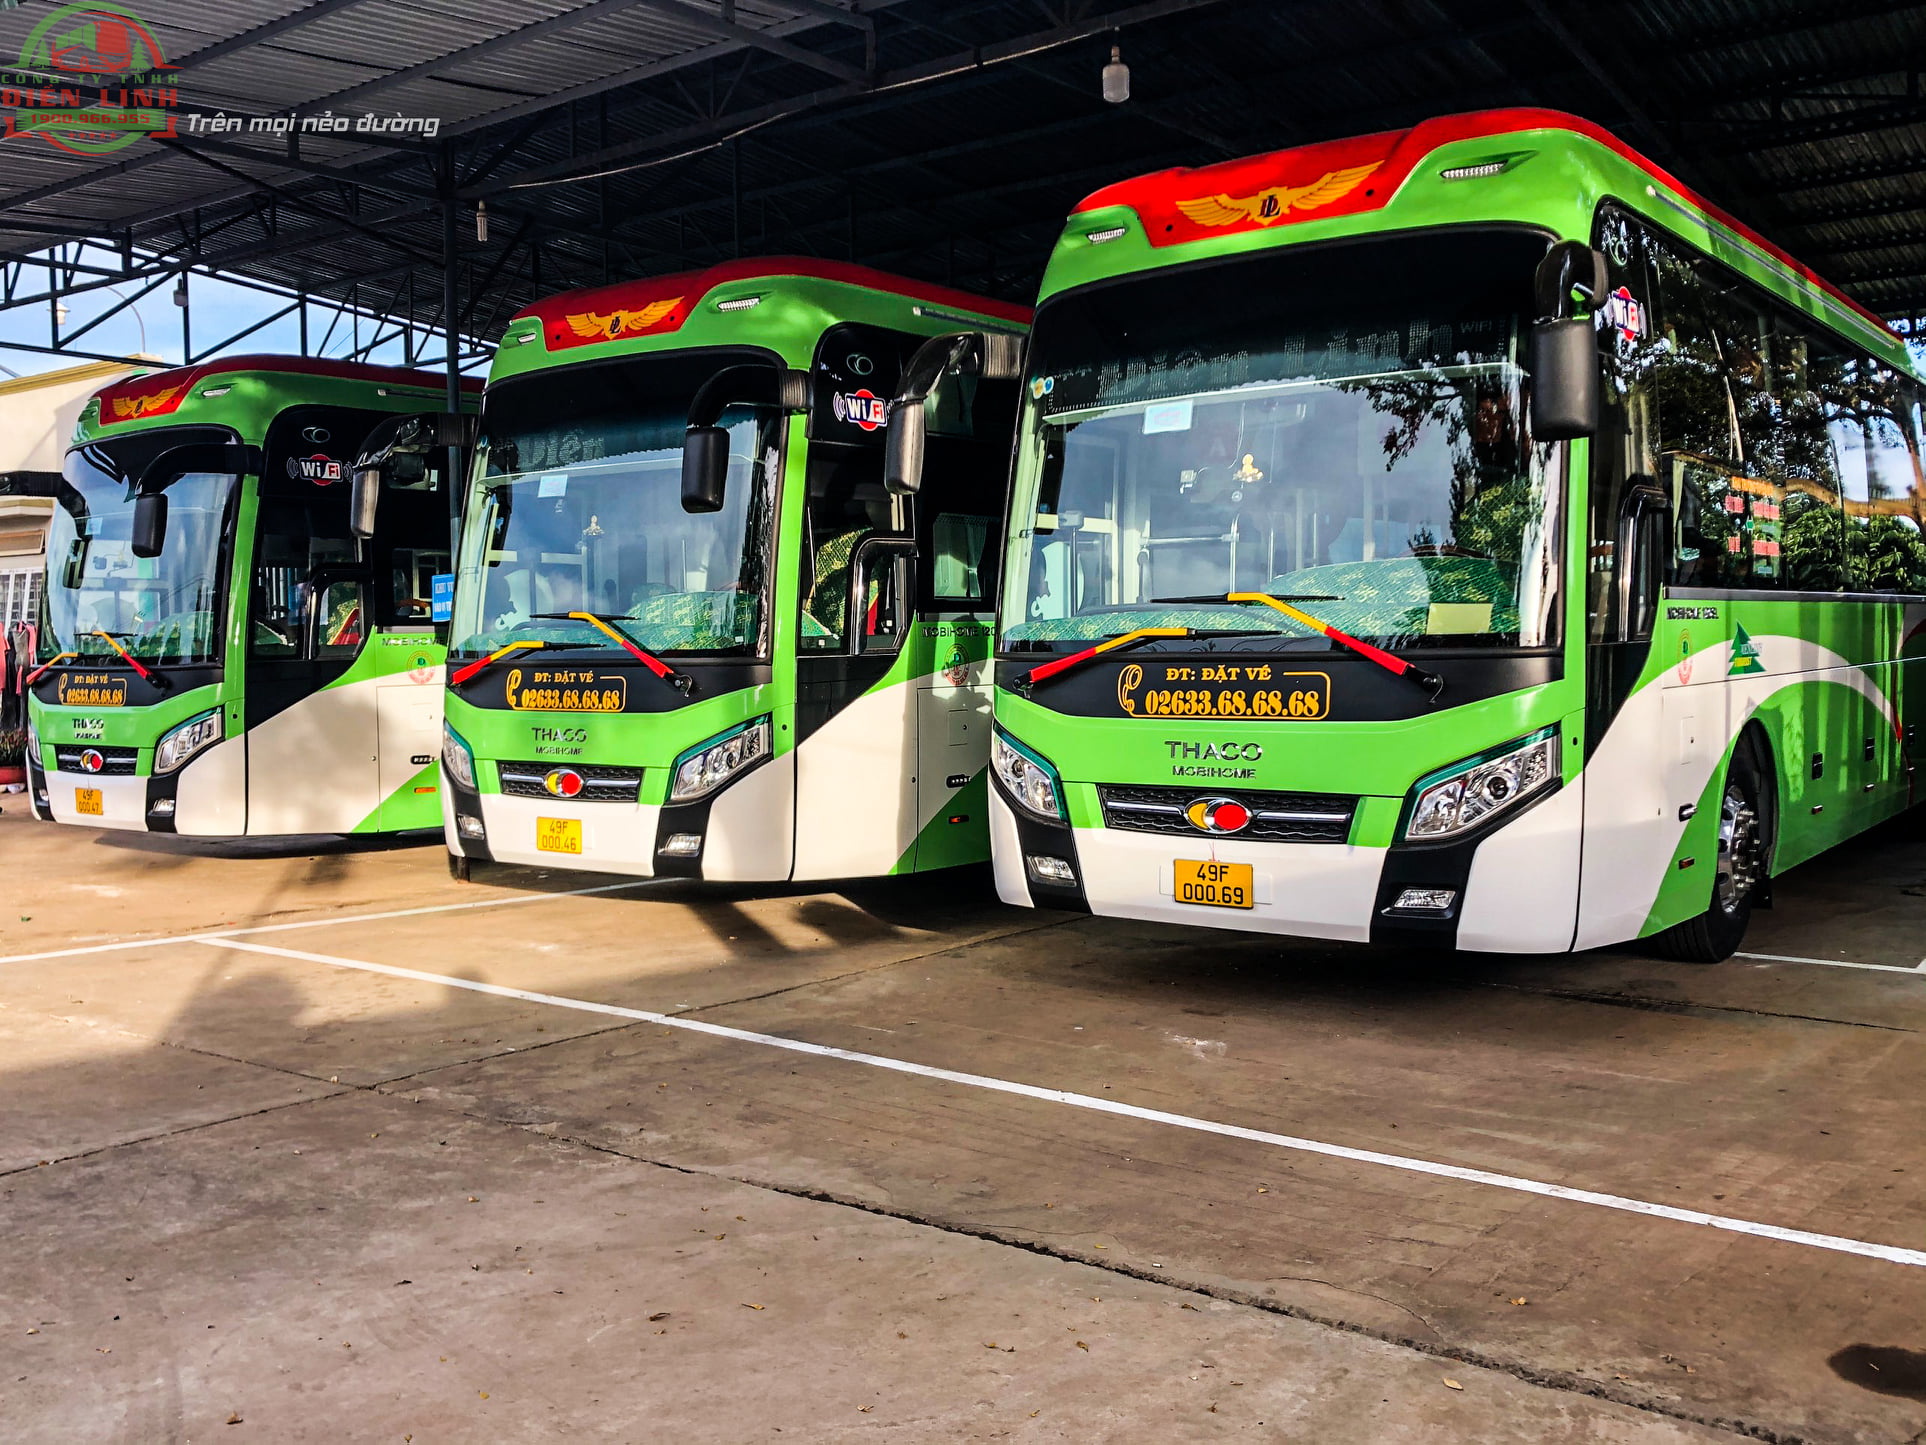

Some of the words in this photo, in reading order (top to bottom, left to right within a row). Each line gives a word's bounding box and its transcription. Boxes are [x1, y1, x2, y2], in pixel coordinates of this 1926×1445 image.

[534, 672, 552, 683] ĐT:
[554, 670, 577, 684] ĐẶT
[579, 670, 594, 683] VÉ
[1166, 667, 1196, 681] ĐT:
[1201, 665, 1240, 683] ĐẶT
[1245, 664, 1272, 681] VÉ
[521, 688, 620, 710] 02633.68.68.68
[1145, 690, 1320, 717] 02633.68.68.68
[531, 727, 587, 743] THACO
[536, 746, 583, 756] MOBIHOME
[1165, 740, 1263, 761] THACO
[1172, 765, 1256, 779] MOBIHOME
[550, 820, 568, 834] 49F
[542, 834, 577, 851] 000.46
[1197, 863, 1229, 882] 49F
[1183, 883, 1244, 905] 000.69
